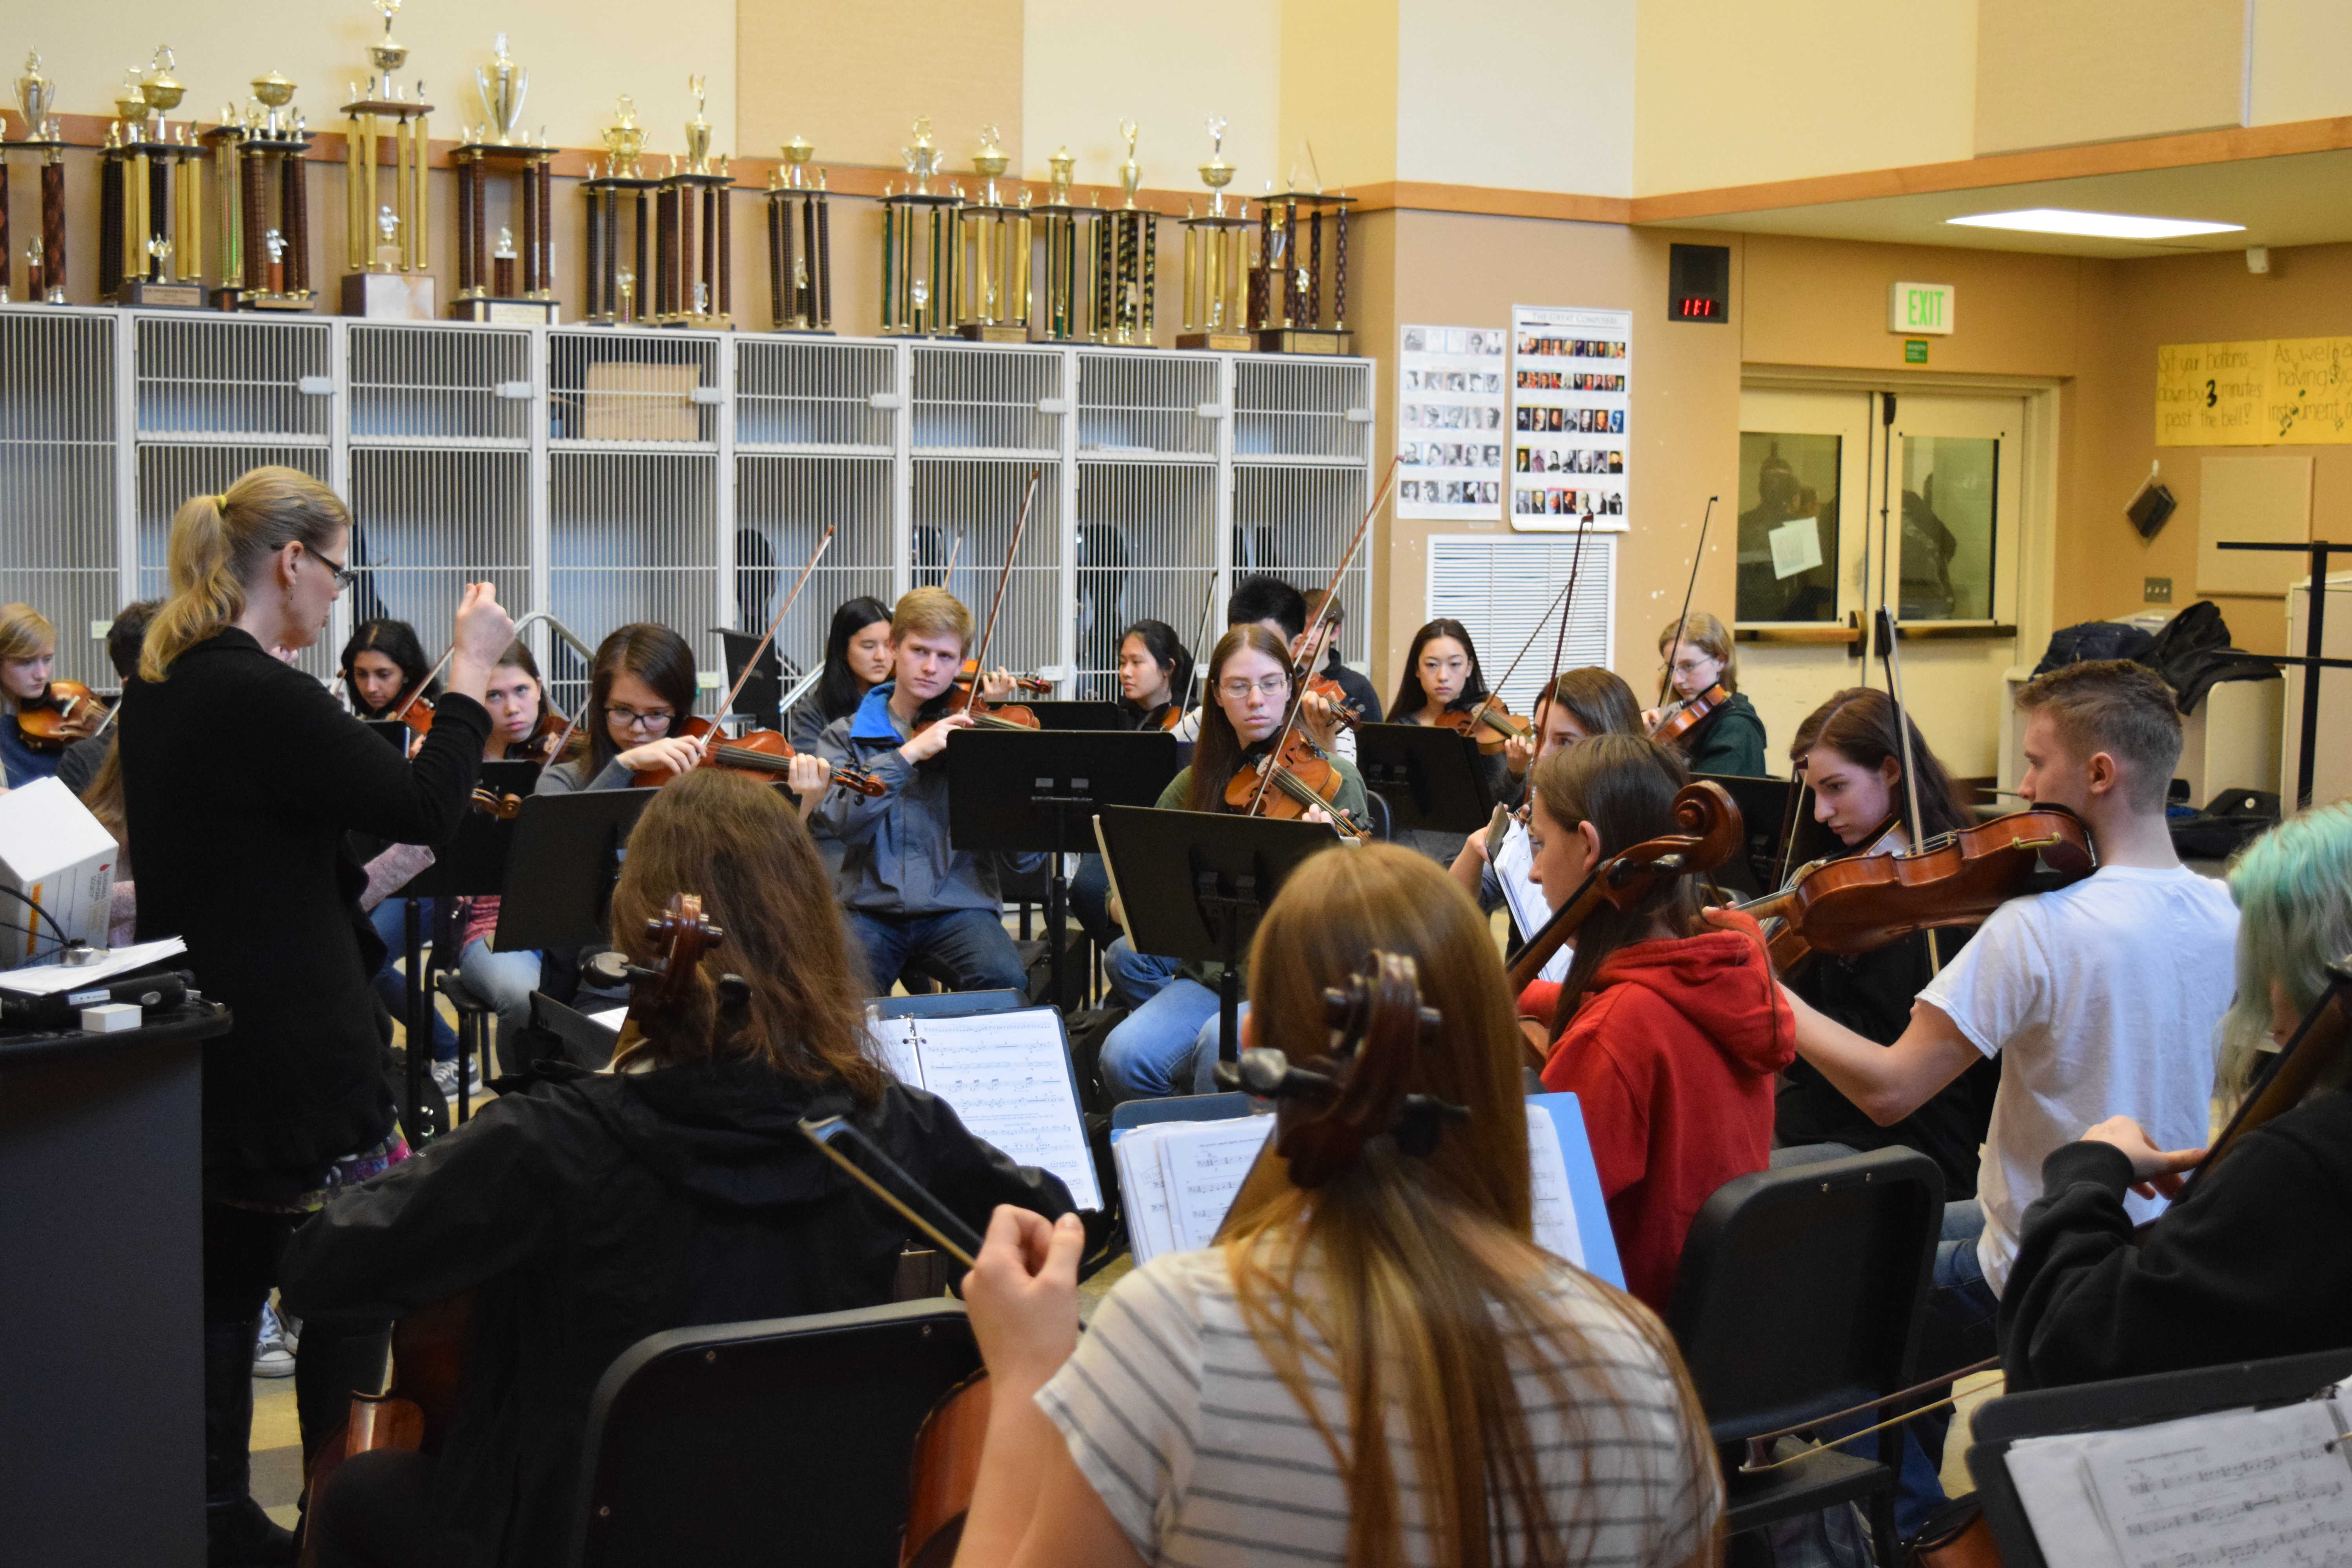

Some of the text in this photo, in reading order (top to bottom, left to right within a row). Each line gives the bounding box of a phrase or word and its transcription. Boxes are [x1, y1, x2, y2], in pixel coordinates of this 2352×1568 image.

[1908, 290, 1945, 326] EXIT
[2206, 379, 2218, 408] 3
[2221, 374, 2263, 398] minutes
[2165, 408, 2192, 432] past
[2201, 408, 2216, 428] the
